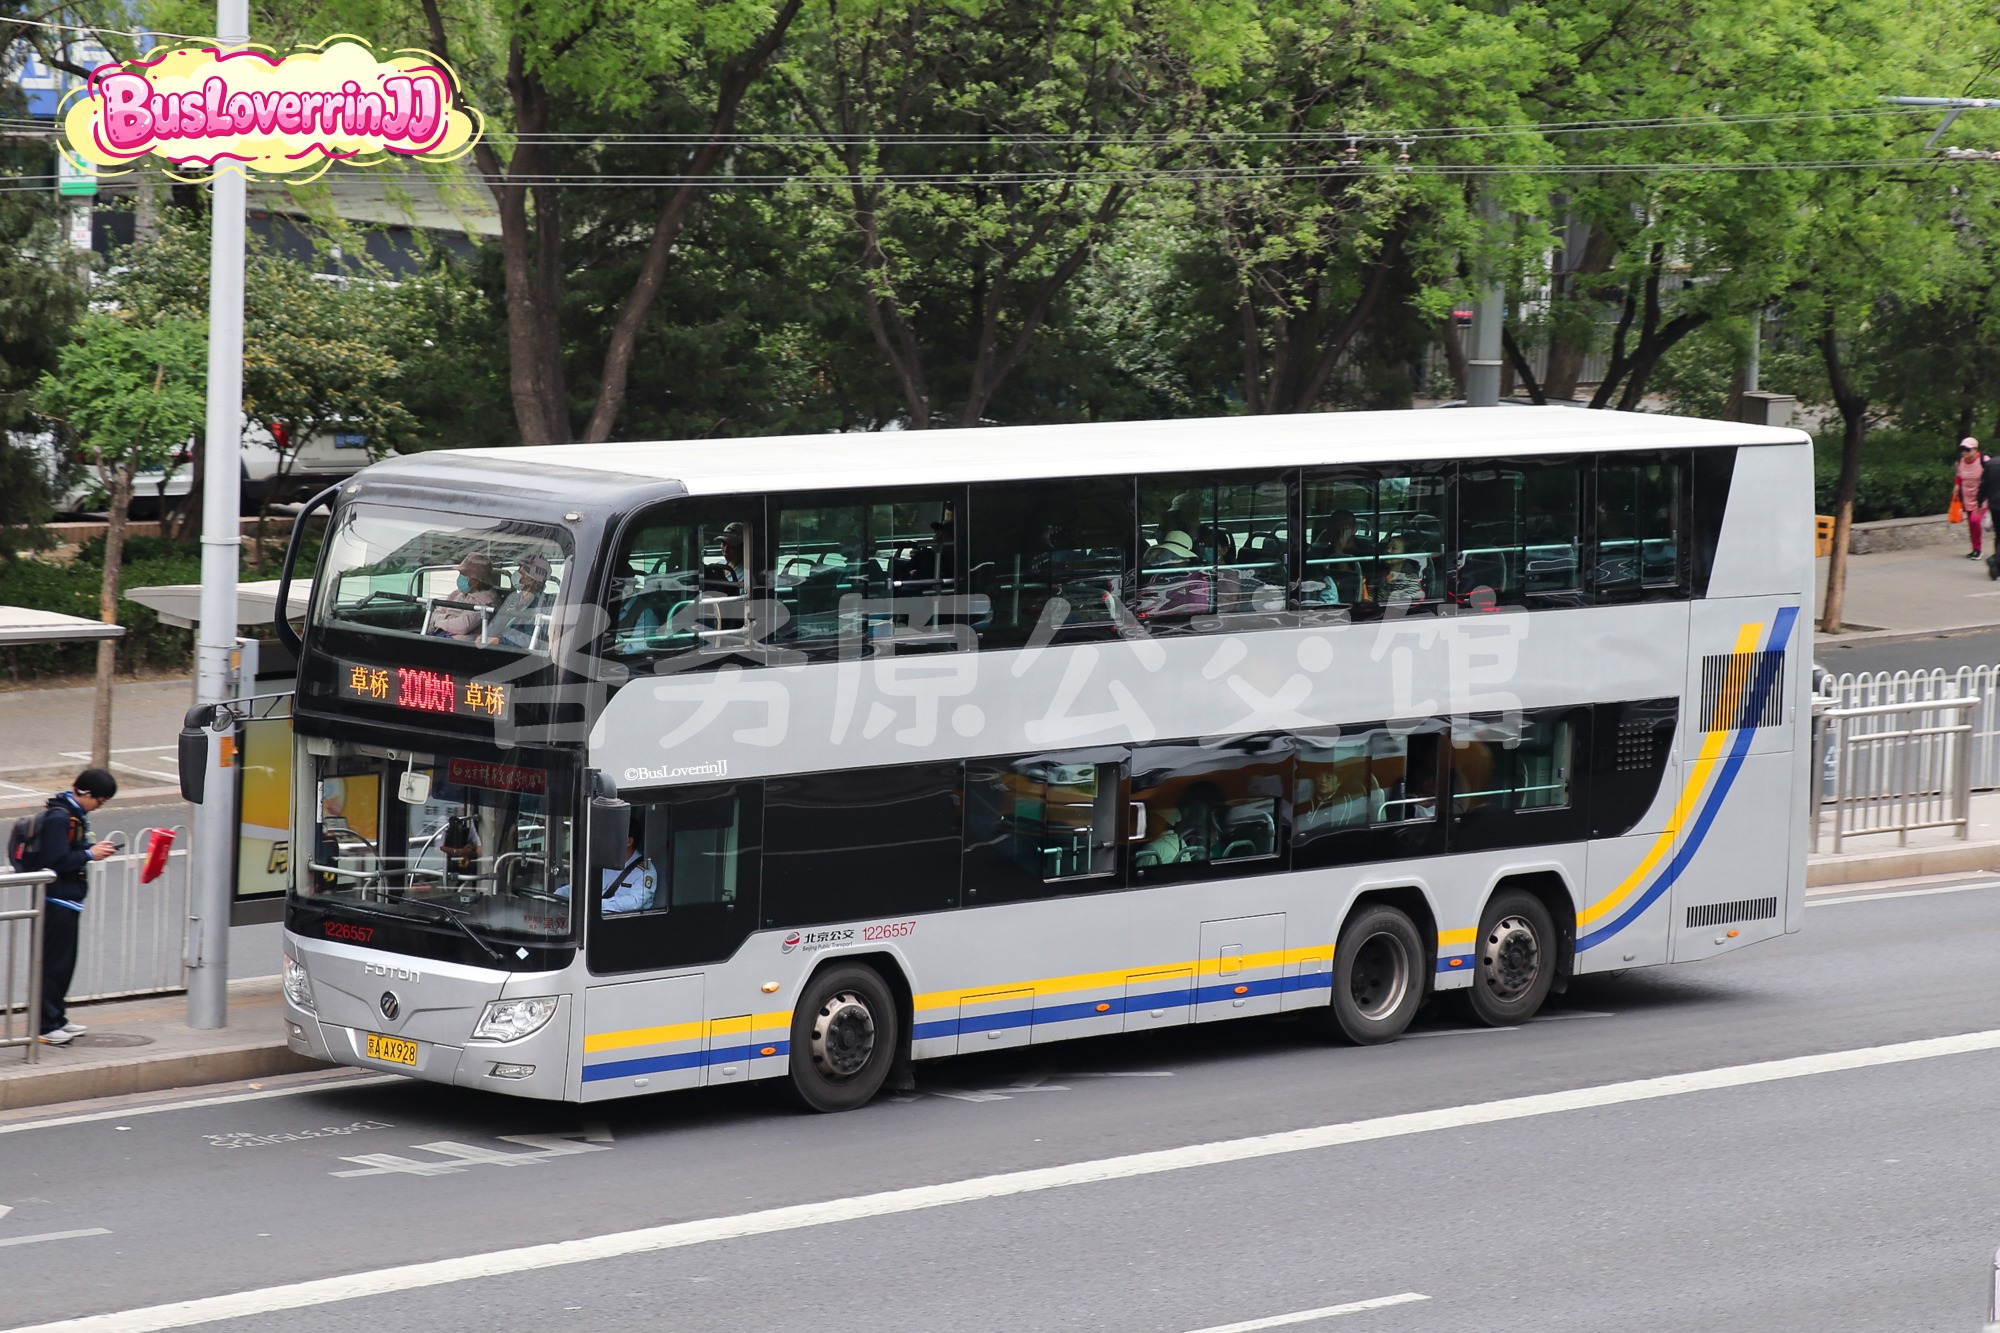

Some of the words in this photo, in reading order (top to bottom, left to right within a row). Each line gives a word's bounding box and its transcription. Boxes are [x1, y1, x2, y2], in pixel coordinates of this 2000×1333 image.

[350, 666, 389, 699] 草桥
[464, 681, 505, 715] 草桥
[323, 921, 374, 942] 1226557
[804, 929, 855, 944] 北京公交
[862, 921, 917, 941] 1226557
[364, 962, 421, 984] FOTON
